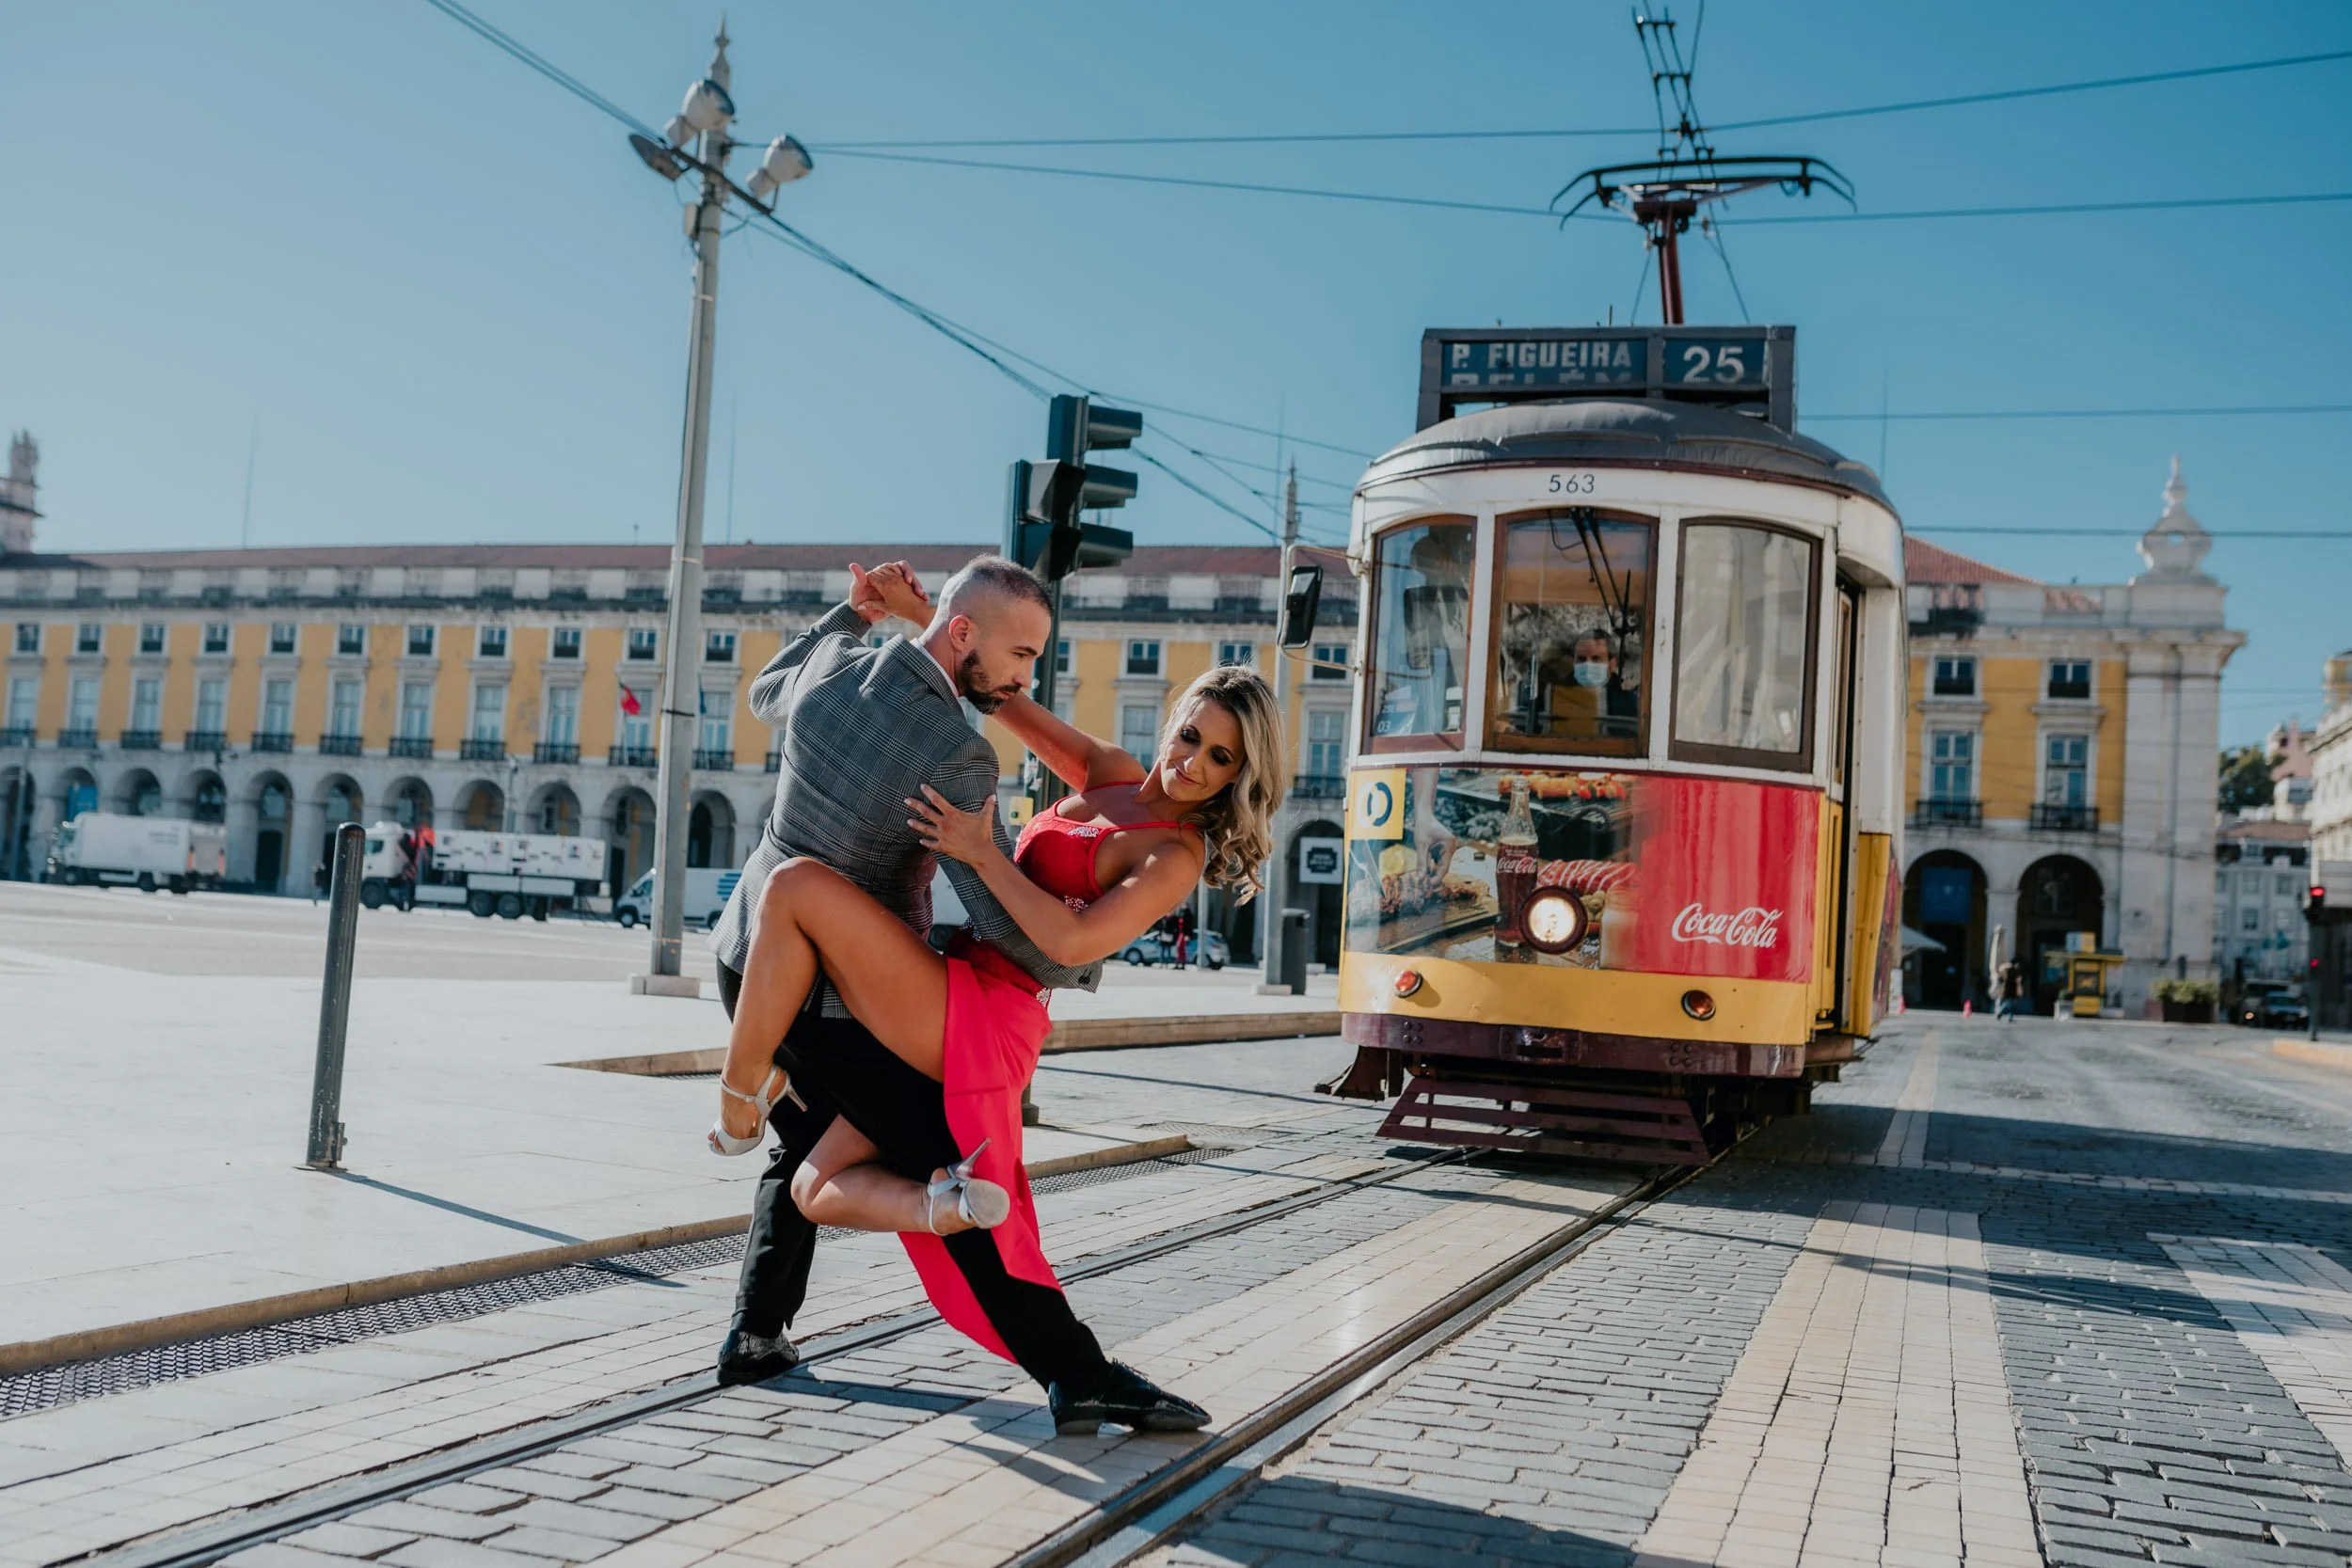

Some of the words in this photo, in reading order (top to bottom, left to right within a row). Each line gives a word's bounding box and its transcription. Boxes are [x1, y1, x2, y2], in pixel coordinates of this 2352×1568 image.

[1453, 342, 1470, 369] P.
[1487, 341, 1631, 368] FIGUEIRA
[1683, 345, 1744, 384] 25
[1549, 474, 1595, 494] 563
[1498, 856, 1537, 874] Coca-Cola
[1672, 903, 1784, 948] Coca-Cola
